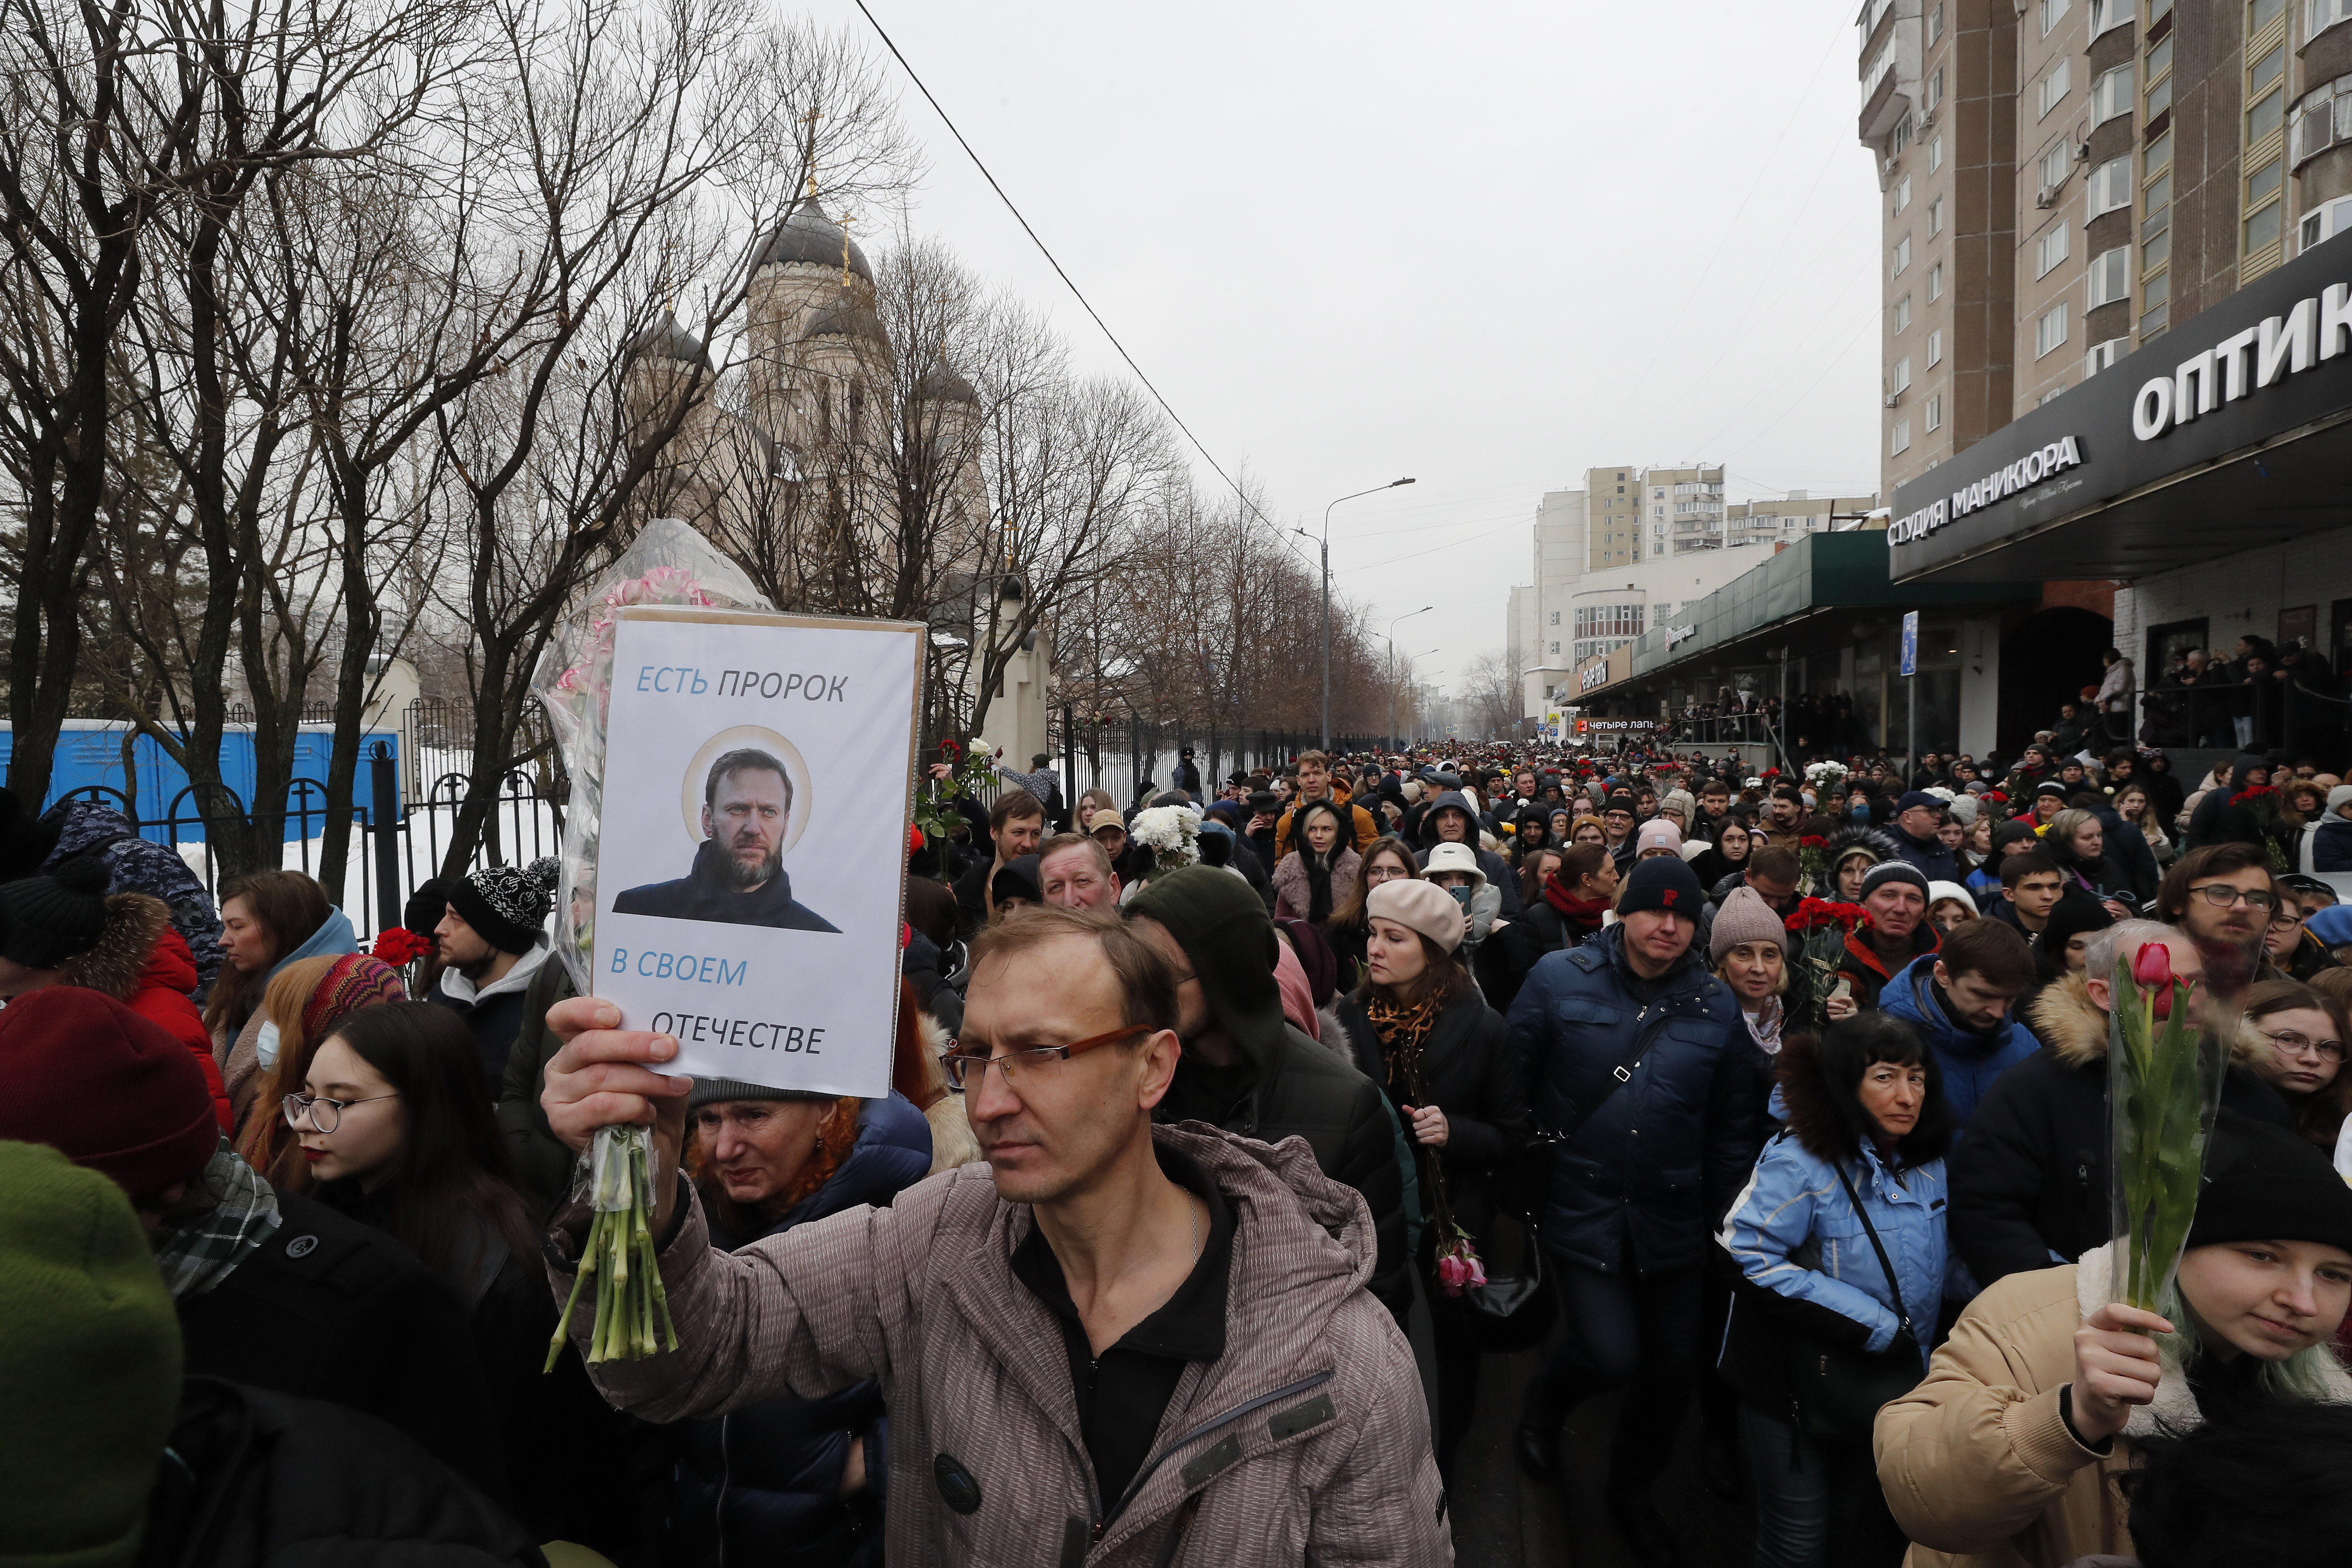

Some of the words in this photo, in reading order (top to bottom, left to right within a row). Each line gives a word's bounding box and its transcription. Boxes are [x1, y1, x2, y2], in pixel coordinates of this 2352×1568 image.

[2133, 283, 2352, 441] ОПТИК
[1887, 499, 1948, 547] СТУДИЯ
[1952, 435, 2080, 519] МАНИКЮРА
[637, 666, 709, 695] ЕСТЬ
[717, 670, 849, 703] ПРОРОК
[1590, 721, 1628, 729] четыре
[1663, 889, 1678, 906] F
[611, 948, 628, 974] В
[637, 950, 748, 986] СВОЕМ
[652, 1012, 825, 1054] ОТЕЧЕСТВЕ
